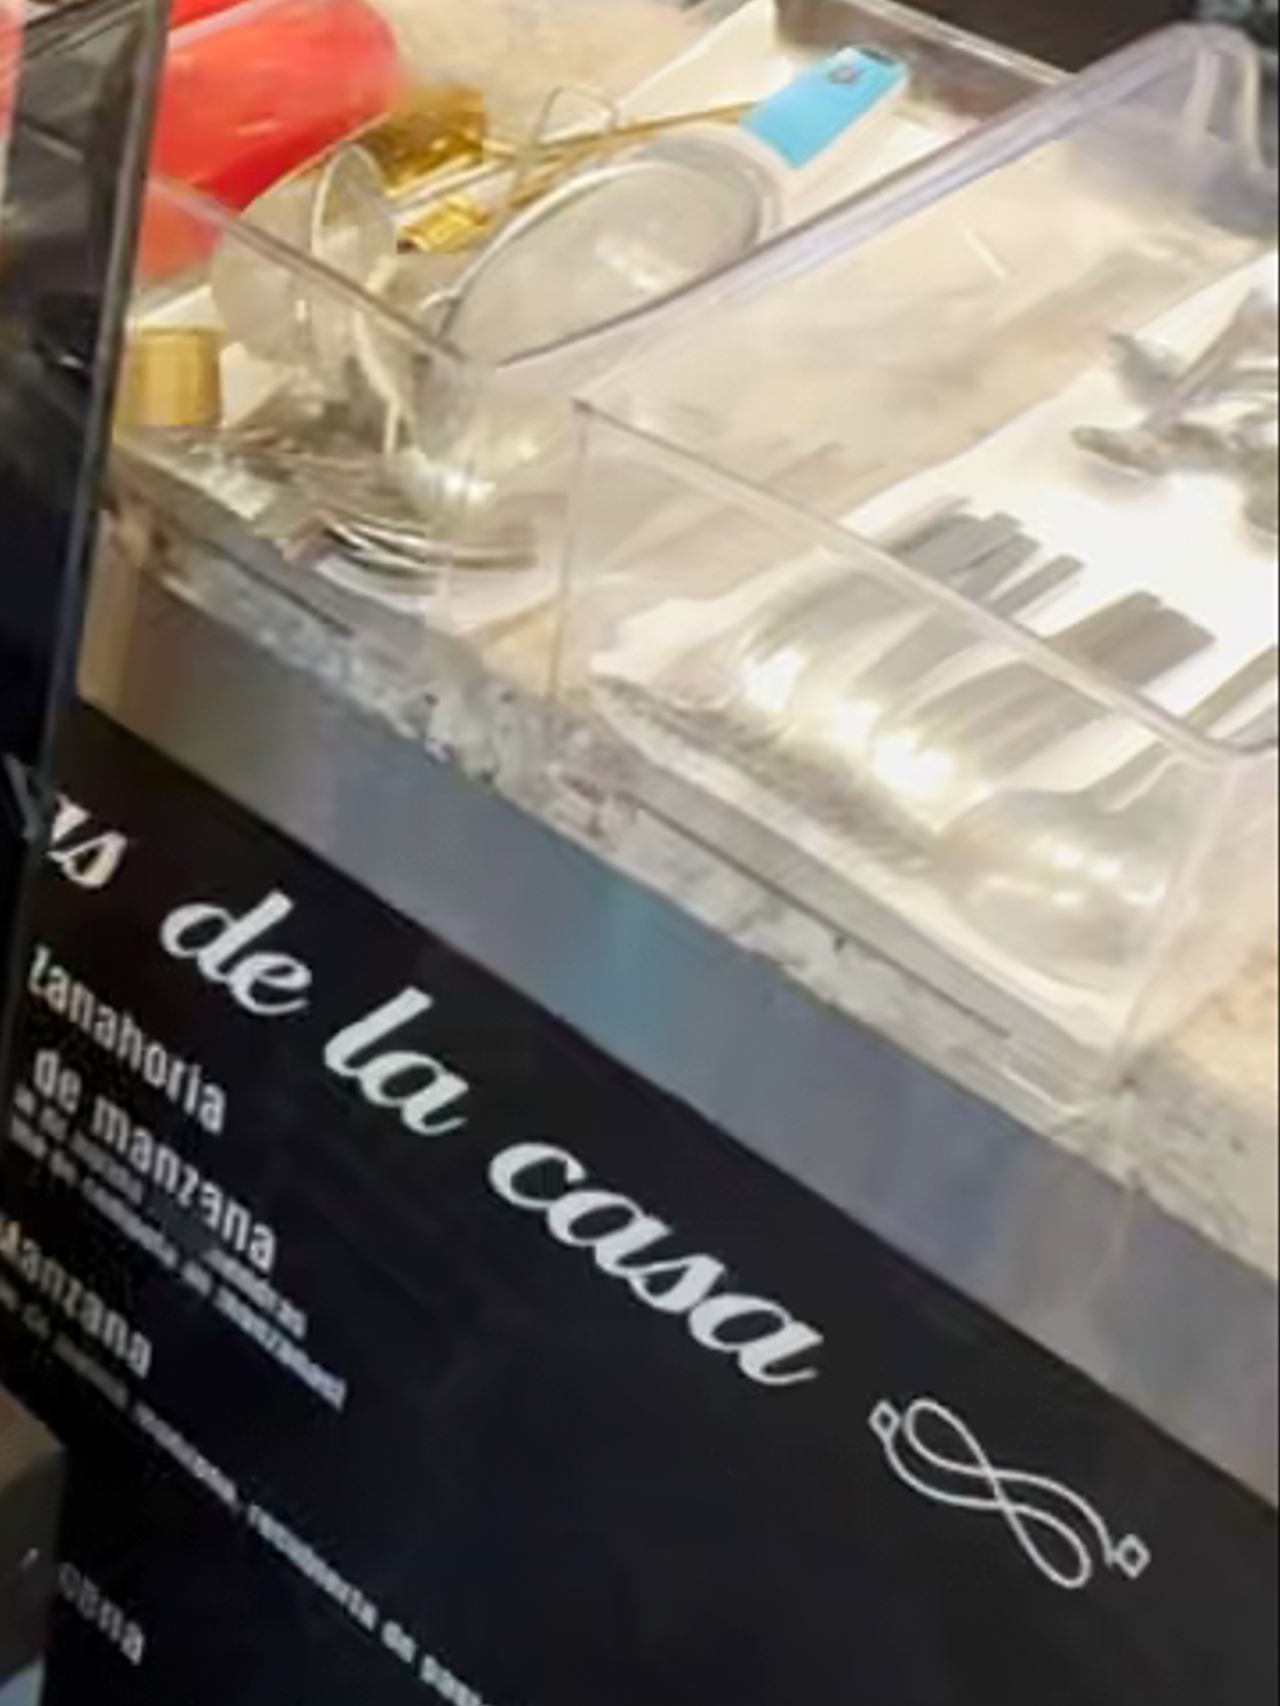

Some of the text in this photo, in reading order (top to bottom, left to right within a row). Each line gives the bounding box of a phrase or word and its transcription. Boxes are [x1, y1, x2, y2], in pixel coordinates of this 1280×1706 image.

[33, 1048, 83, 1116] de
[91, 1093, 278, 1276] manzana
[159, 890, 312, 1016] de
[324, 986, 469, 1138] la
[487, 1140, 824, 1387] casa
